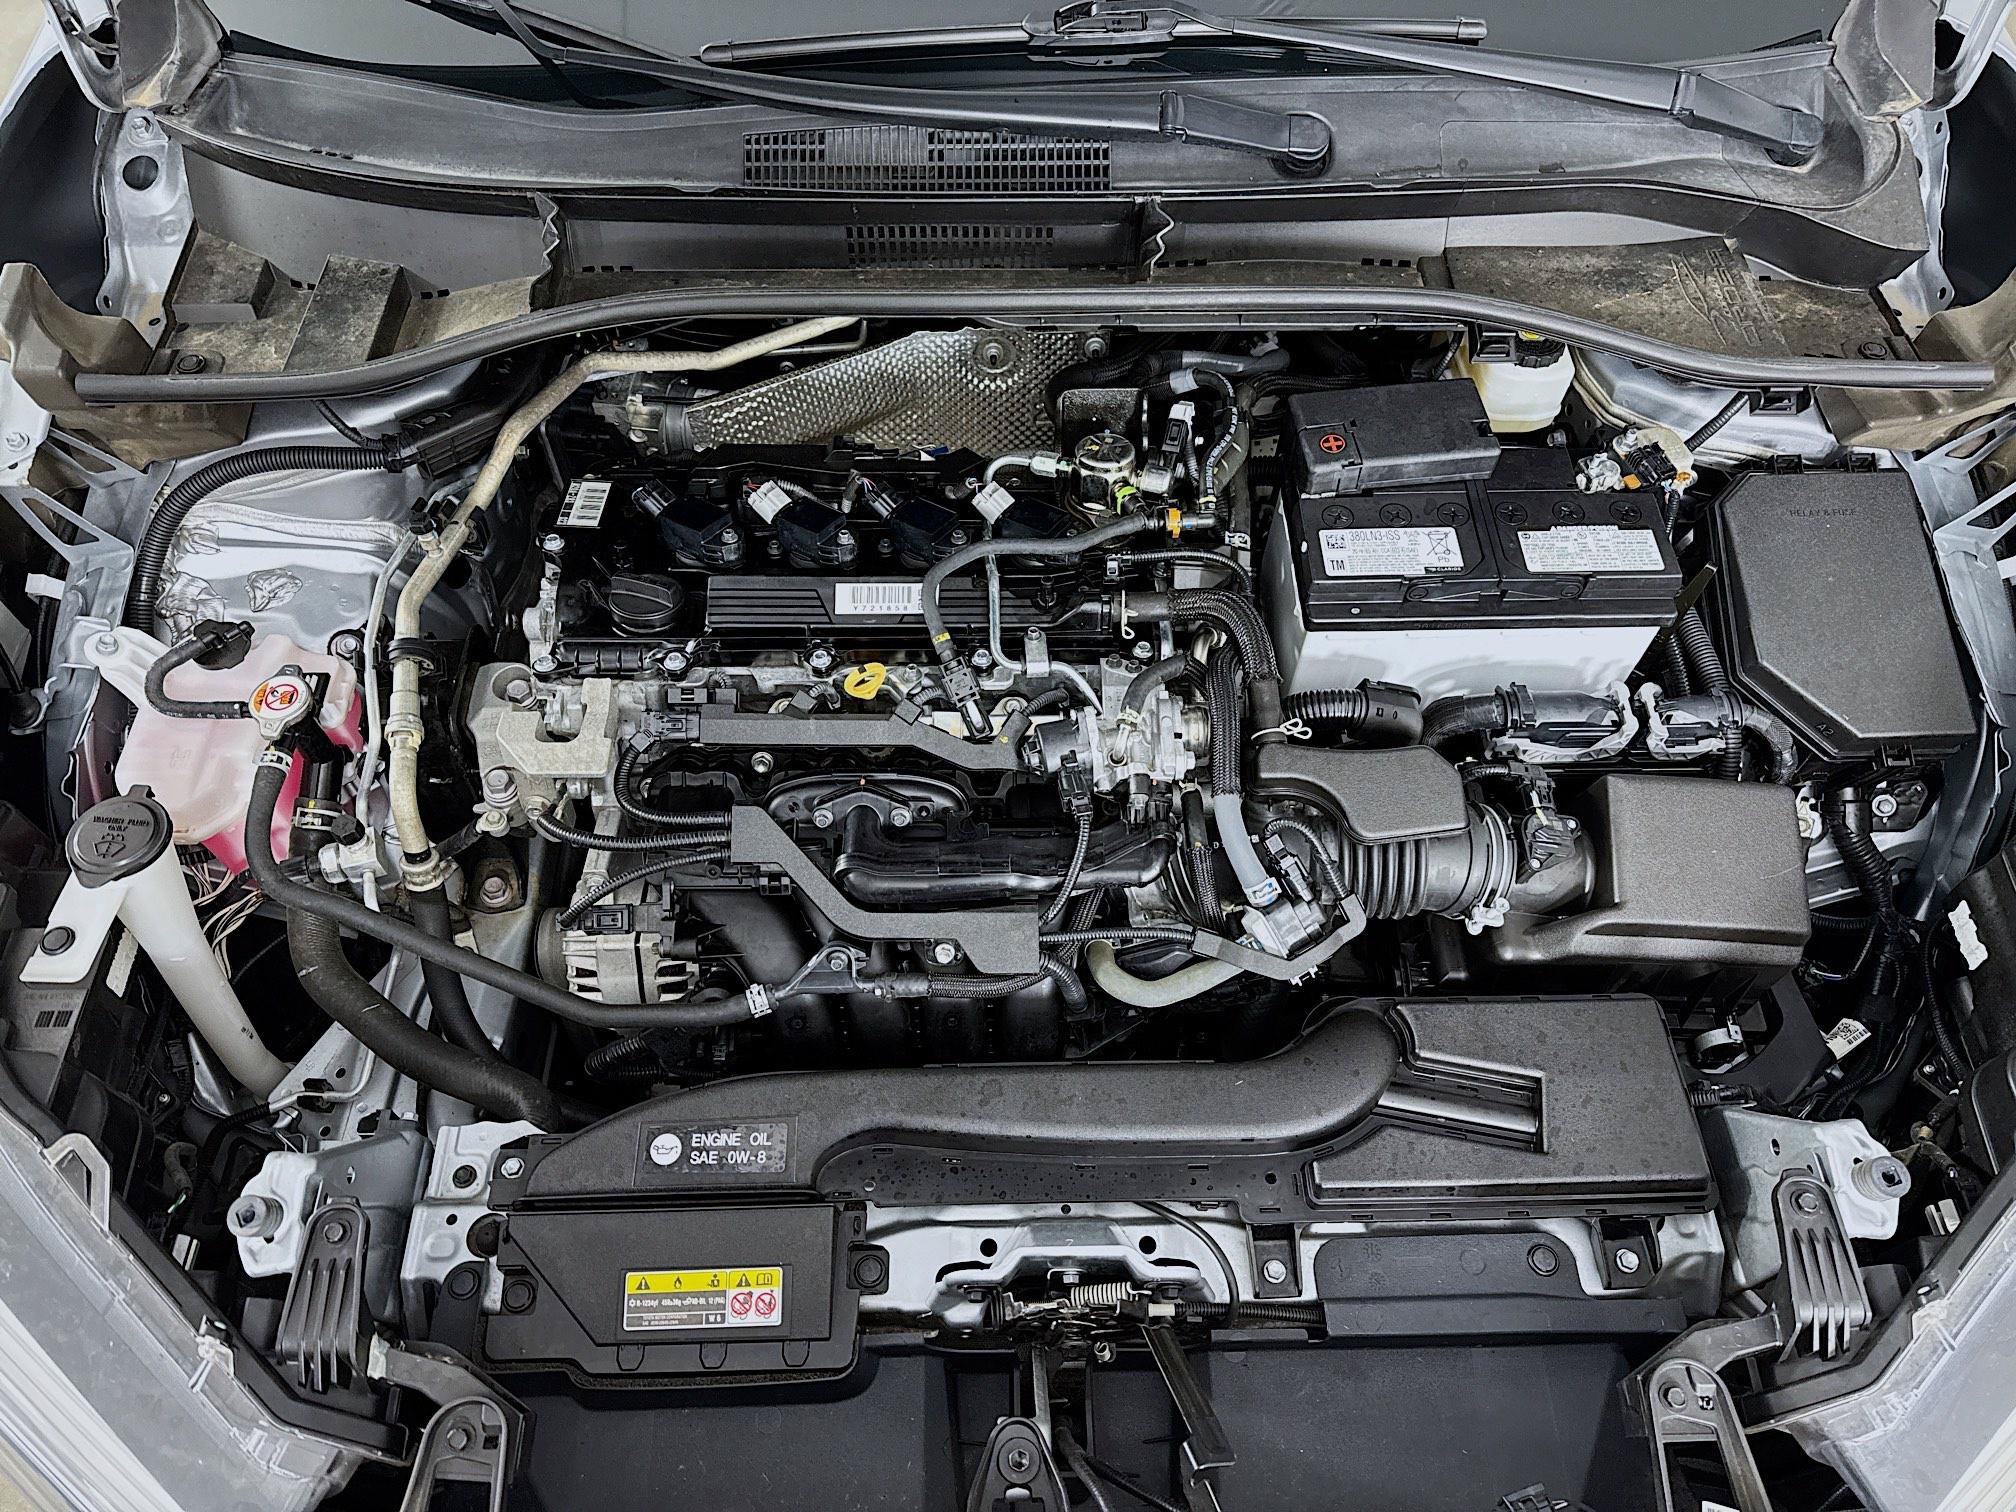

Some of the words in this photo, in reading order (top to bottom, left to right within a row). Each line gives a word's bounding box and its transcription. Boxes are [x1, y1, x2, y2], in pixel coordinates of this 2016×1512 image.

[1704, 248, 1763, 347] CROSS
[1789, 509, 1820, 517] RELAY
[1349, 530, 1401, 542] 380LN3-ISS
[1329, 559, 1346, 571] TM
[691, 1132, 742, 1147] ENGINE
[749, 1132, 772, 1146] OIL
[689, 1150, 719, 1164] SAE
[727, 1150, 767, 1164] 0W-8
[636, 1299, 659, 1308] R-1234yf
